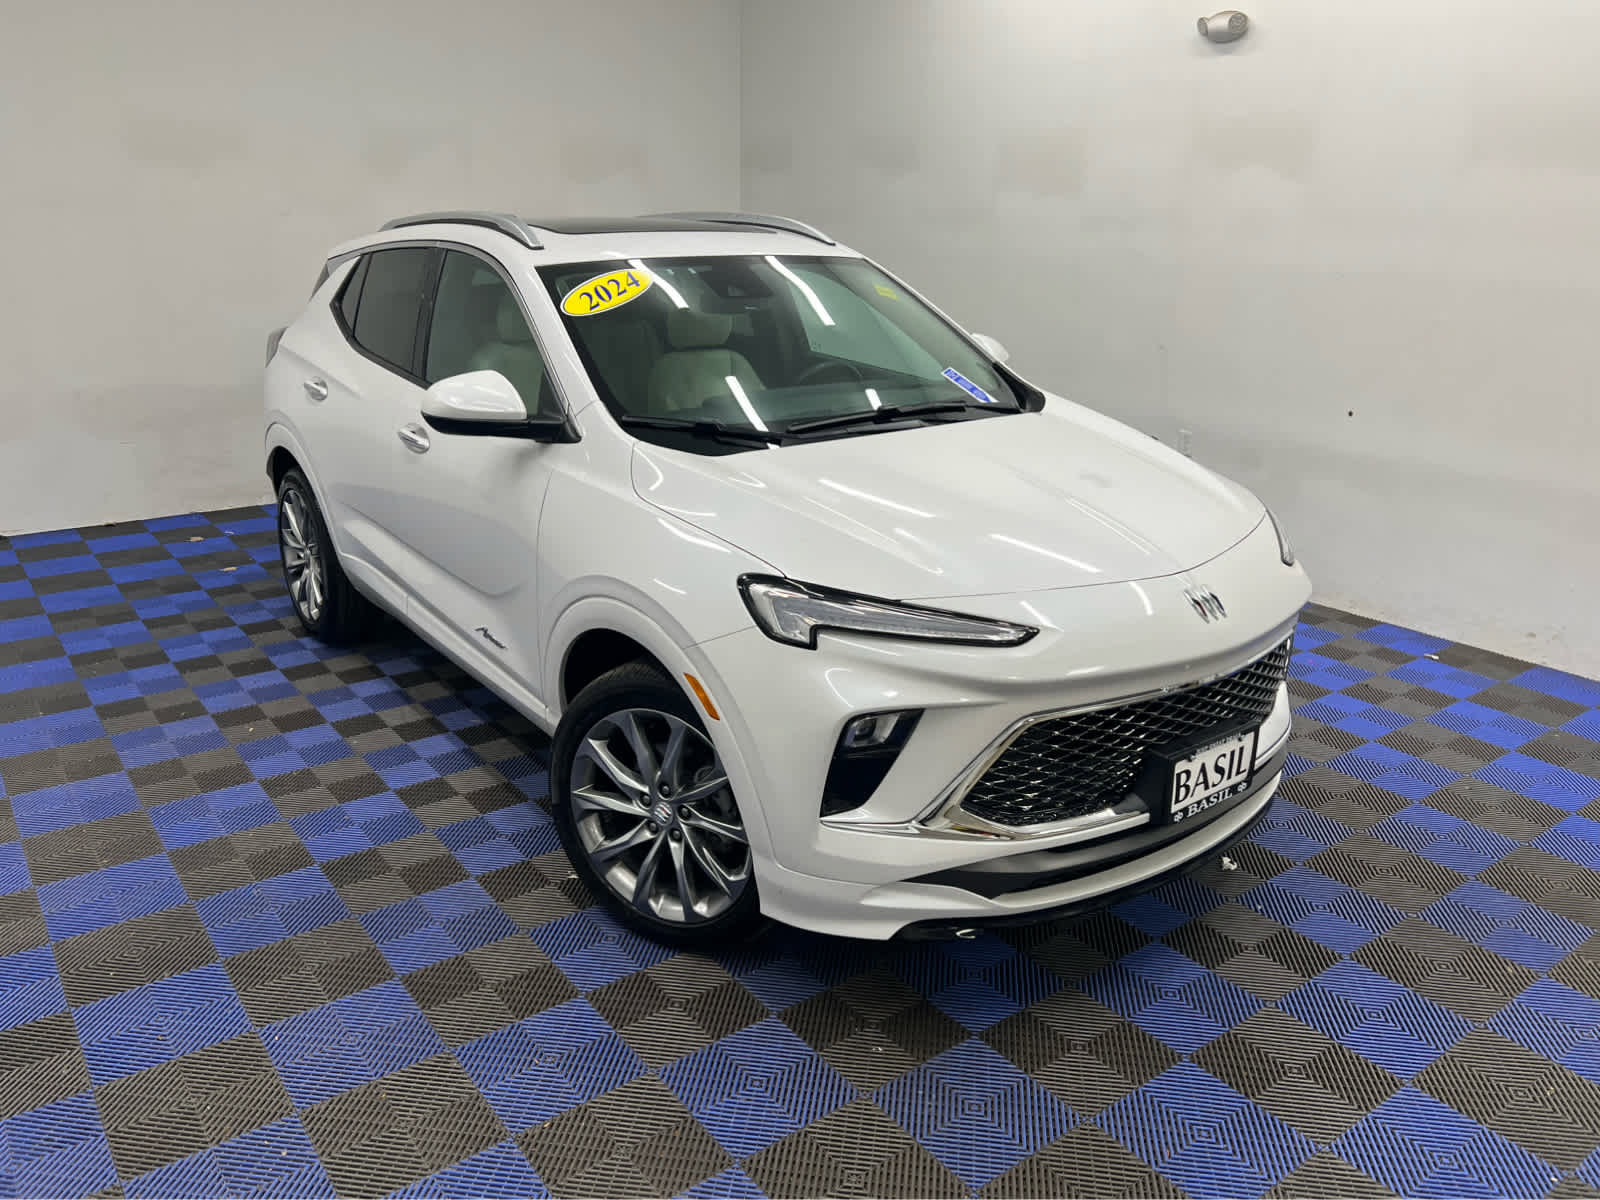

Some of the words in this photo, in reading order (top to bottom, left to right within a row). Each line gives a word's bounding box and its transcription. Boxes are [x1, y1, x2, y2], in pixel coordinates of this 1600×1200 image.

[580, 271, 640, 310] 2024
[1174, 746, 1247, 805] BASIL
[1187, 787, 1233, 818] BASIL
